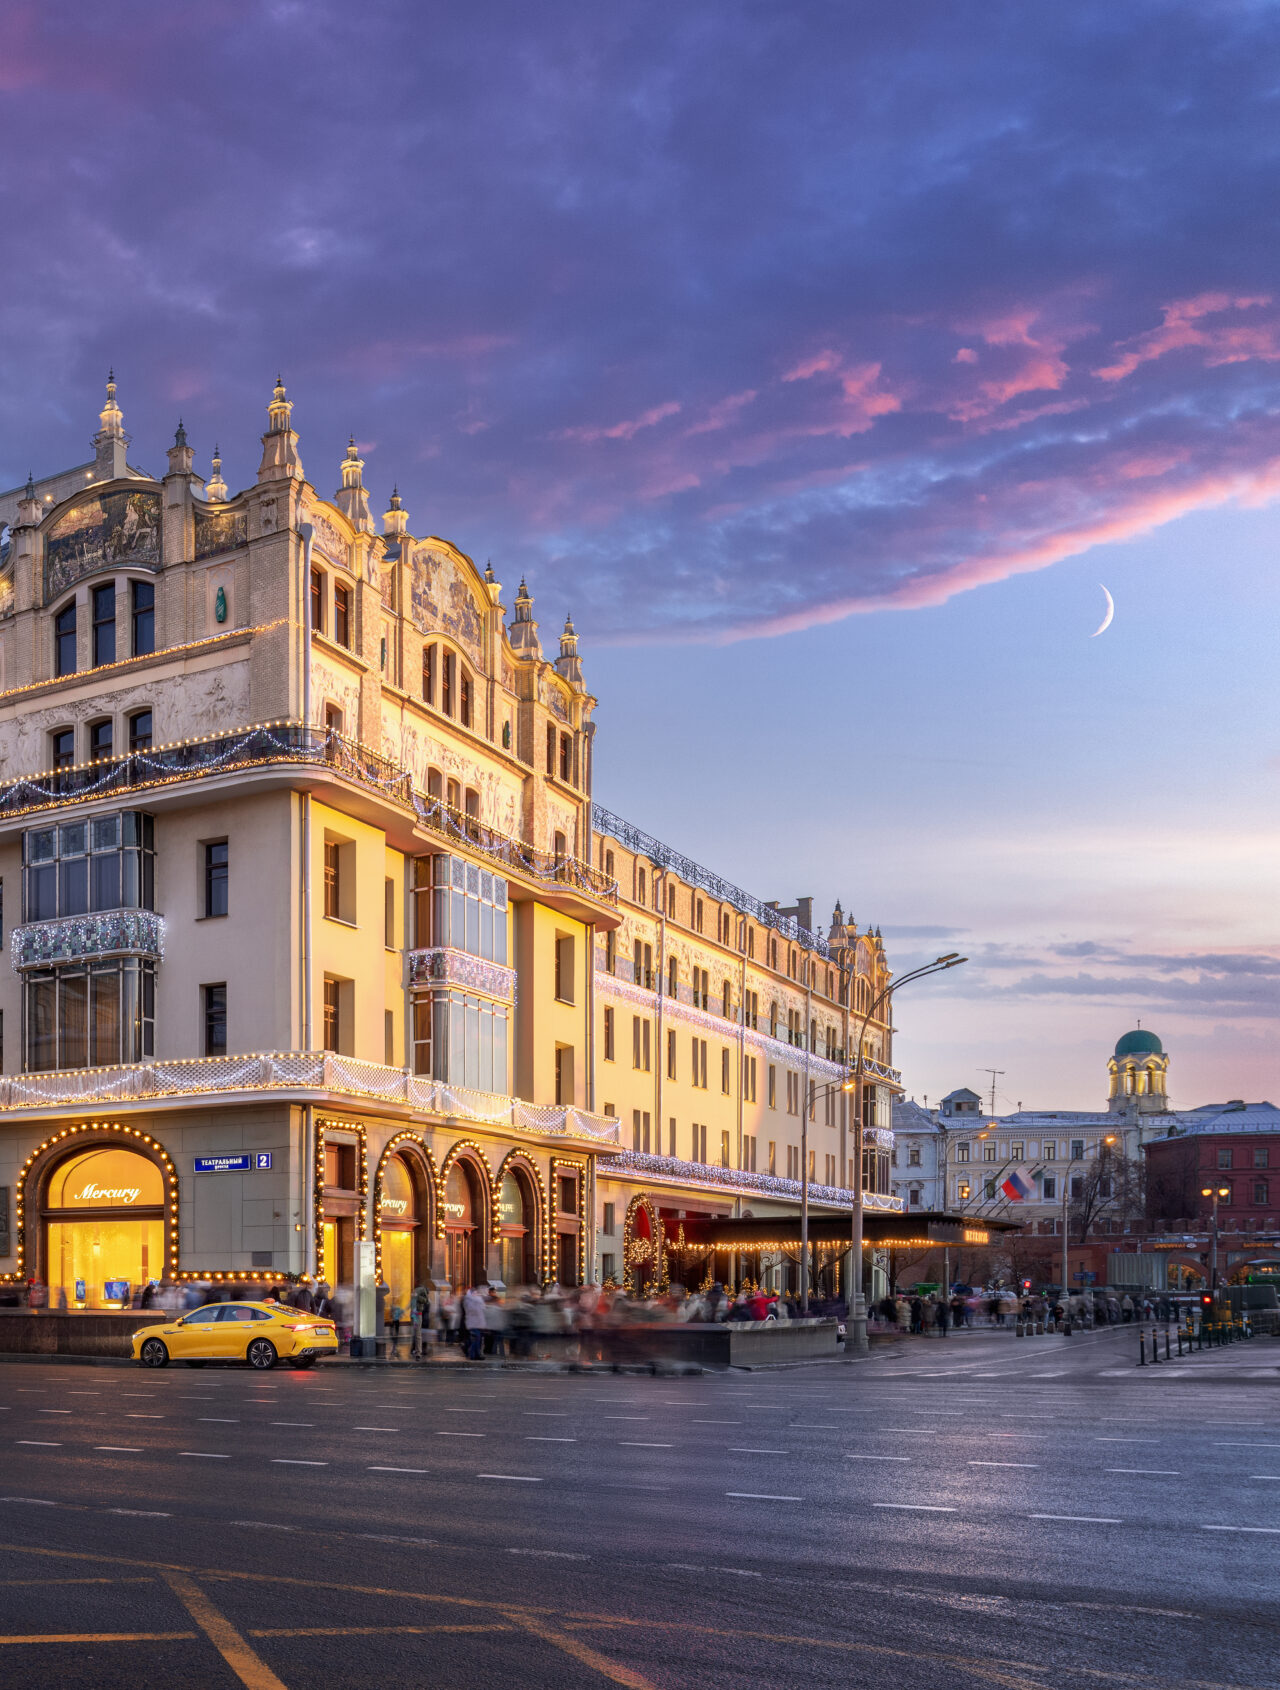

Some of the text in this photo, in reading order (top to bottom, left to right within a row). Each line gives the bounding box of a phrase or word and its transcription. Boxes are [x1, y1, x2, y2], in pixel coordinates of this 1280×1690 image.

[201, 1157, 243, 1166] ТЕАТРАЛЬНЫЙ
[259, 1155, 267, 1167] 2
[74, 1183, 141, 1203] Mercury
